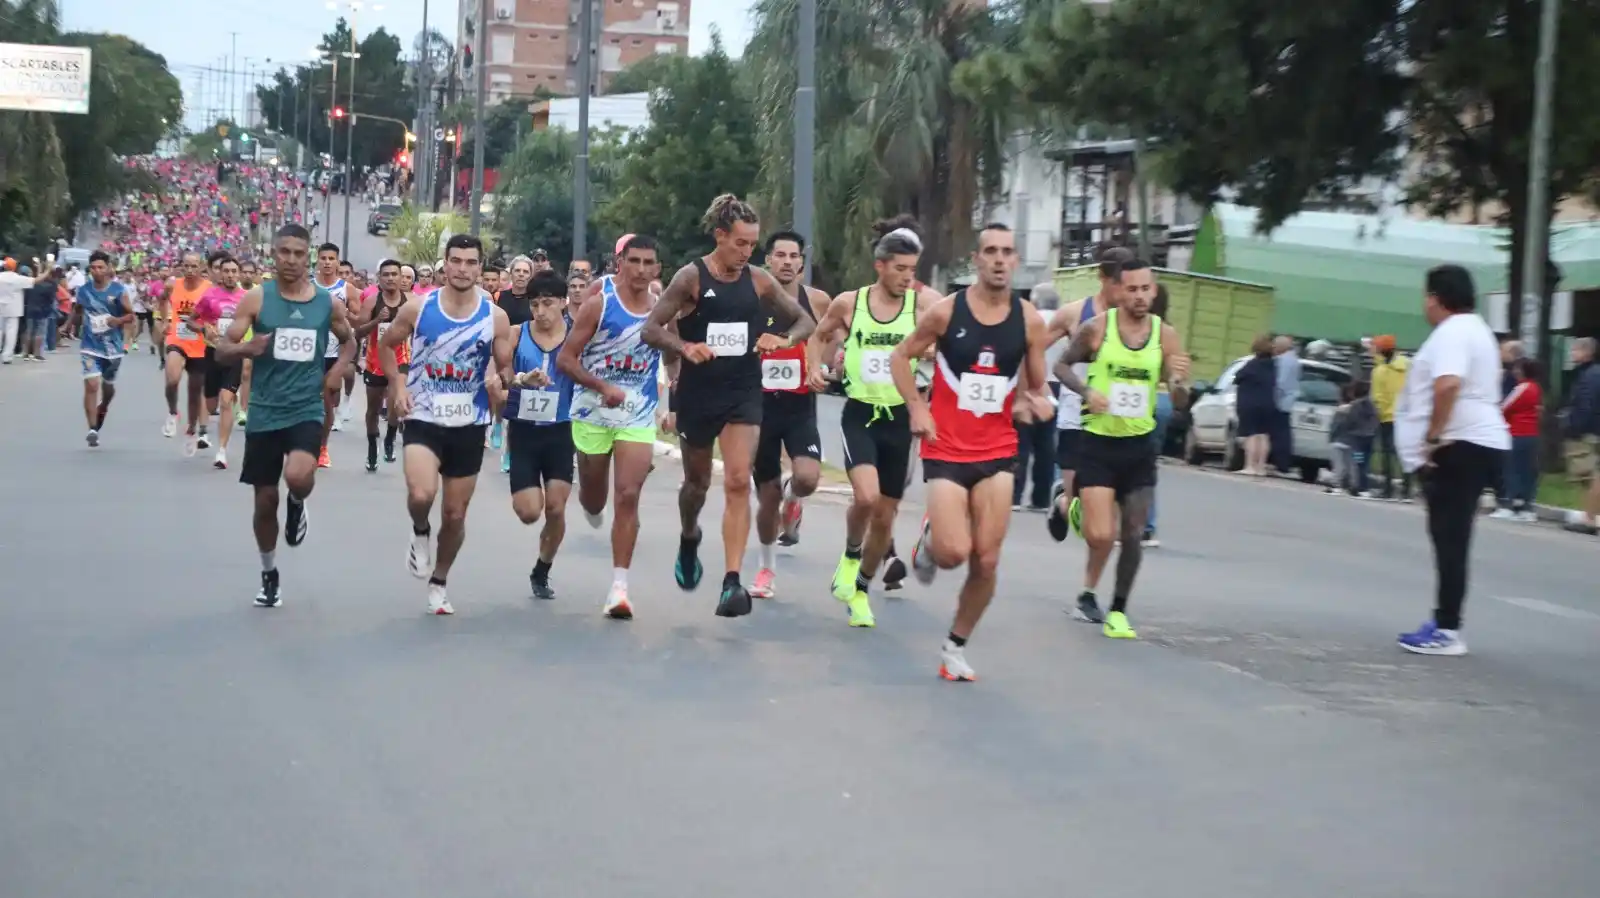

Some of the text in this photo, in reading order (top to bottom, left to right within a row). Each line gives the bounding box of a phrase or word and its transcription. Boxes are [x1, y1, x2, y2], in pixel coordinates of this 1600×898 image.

[276, 335, 313, 352] 366
[707, 334, 746, 347] 1064
[769, 366, 793, 380] 20
[968, 382, 997, 402] 31
[1117, 391, 1142, 408] 33
[434, 403, 472, 418] 1540
[527, 396, 551, 412] 17
